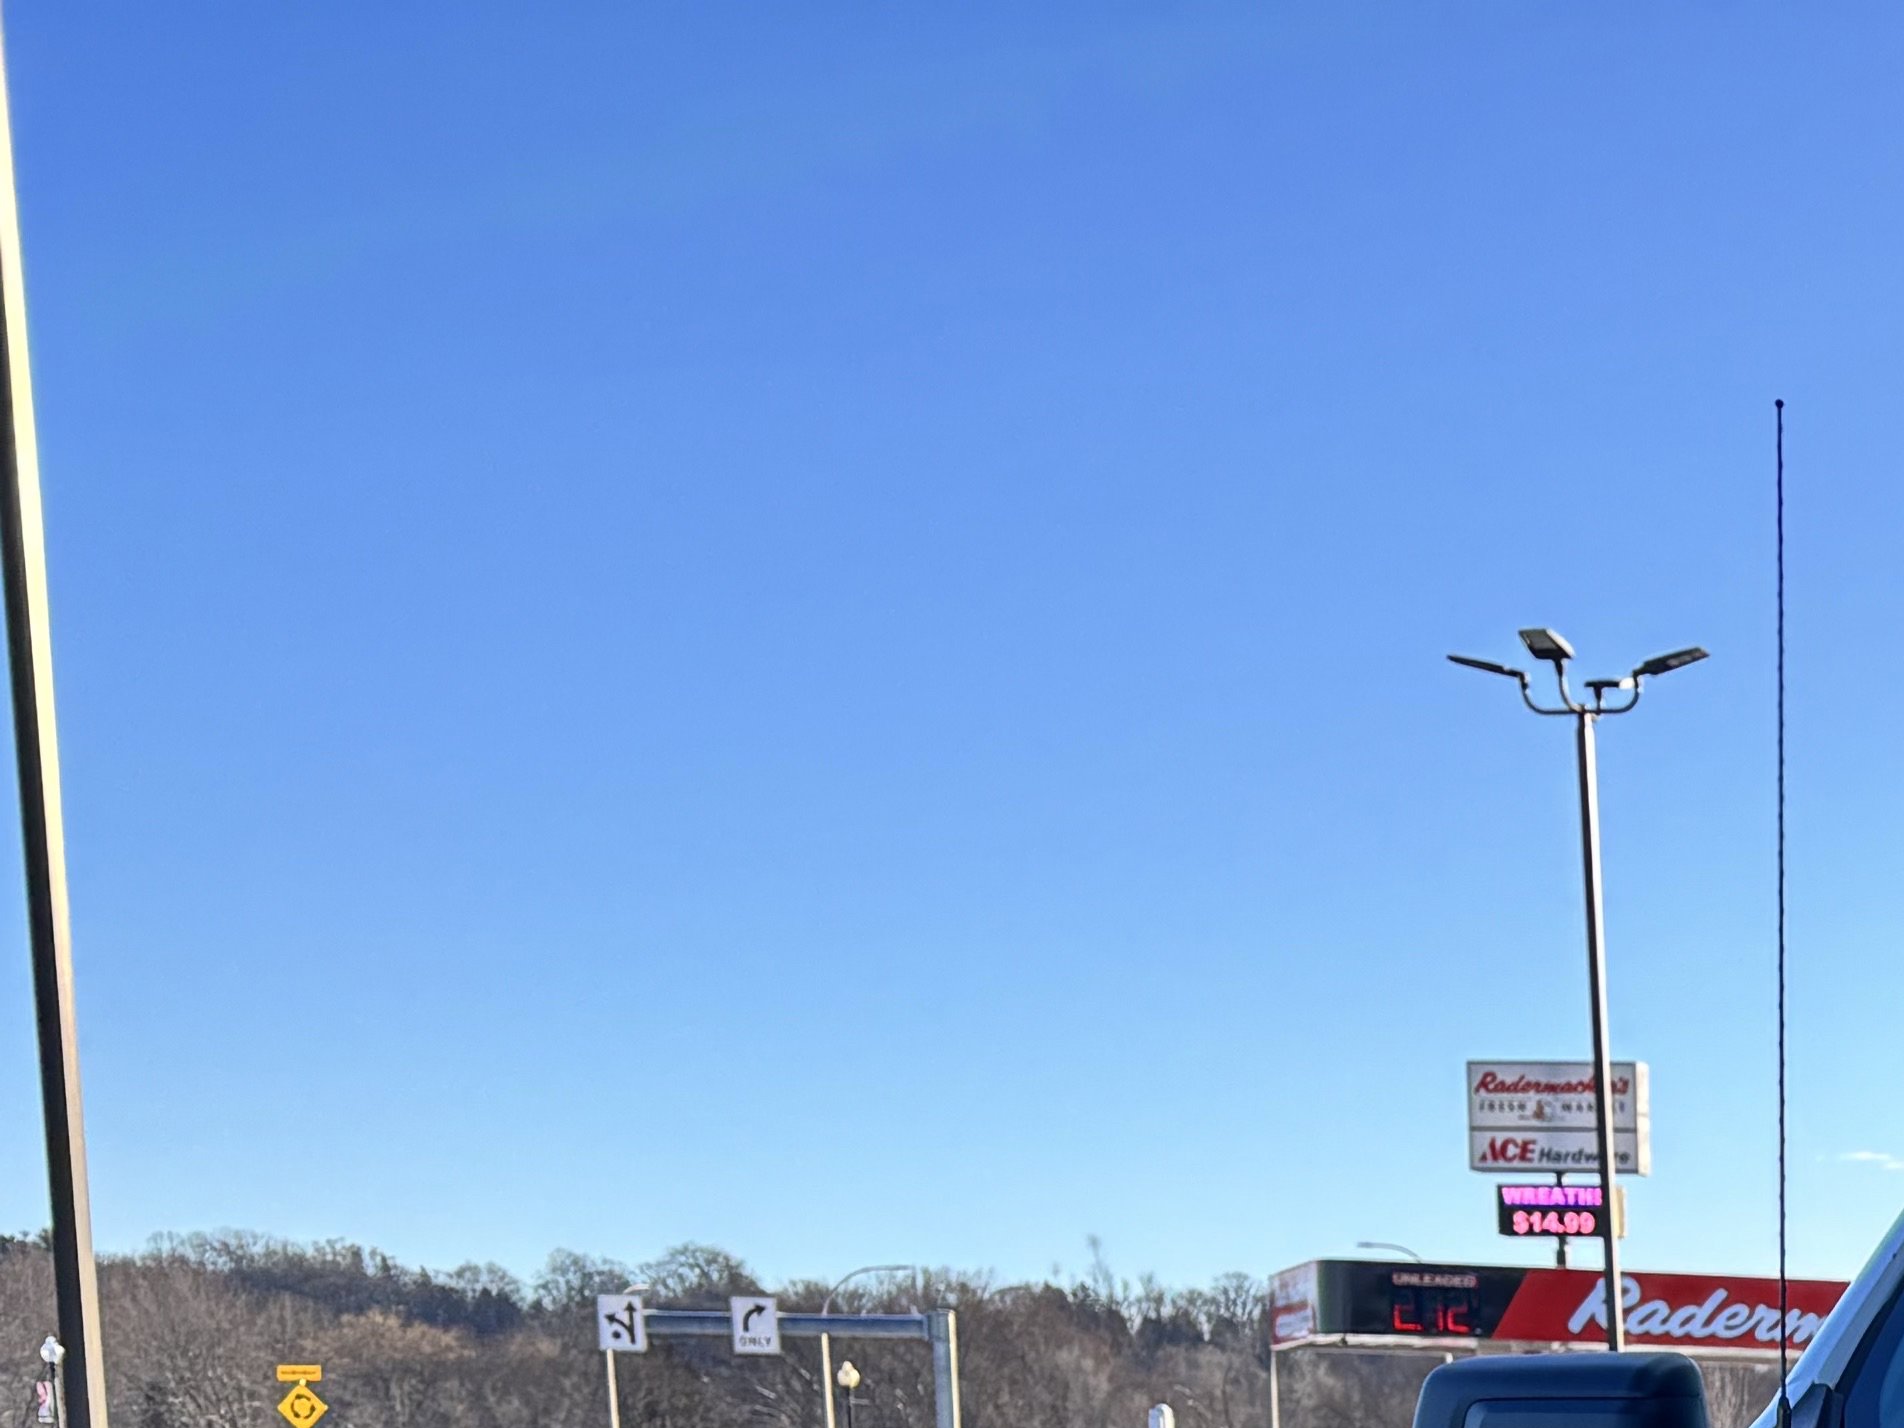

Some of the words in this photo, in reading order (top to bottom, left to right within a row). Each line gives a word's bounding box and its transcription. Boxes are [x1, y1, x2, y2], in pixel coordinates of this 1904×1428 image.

[1479, 1136, 1536, 1163] ACE
[1538, 1147, 1630, 1165] Hardwe
[1512, 1210, 1595, 1235] $14.99
